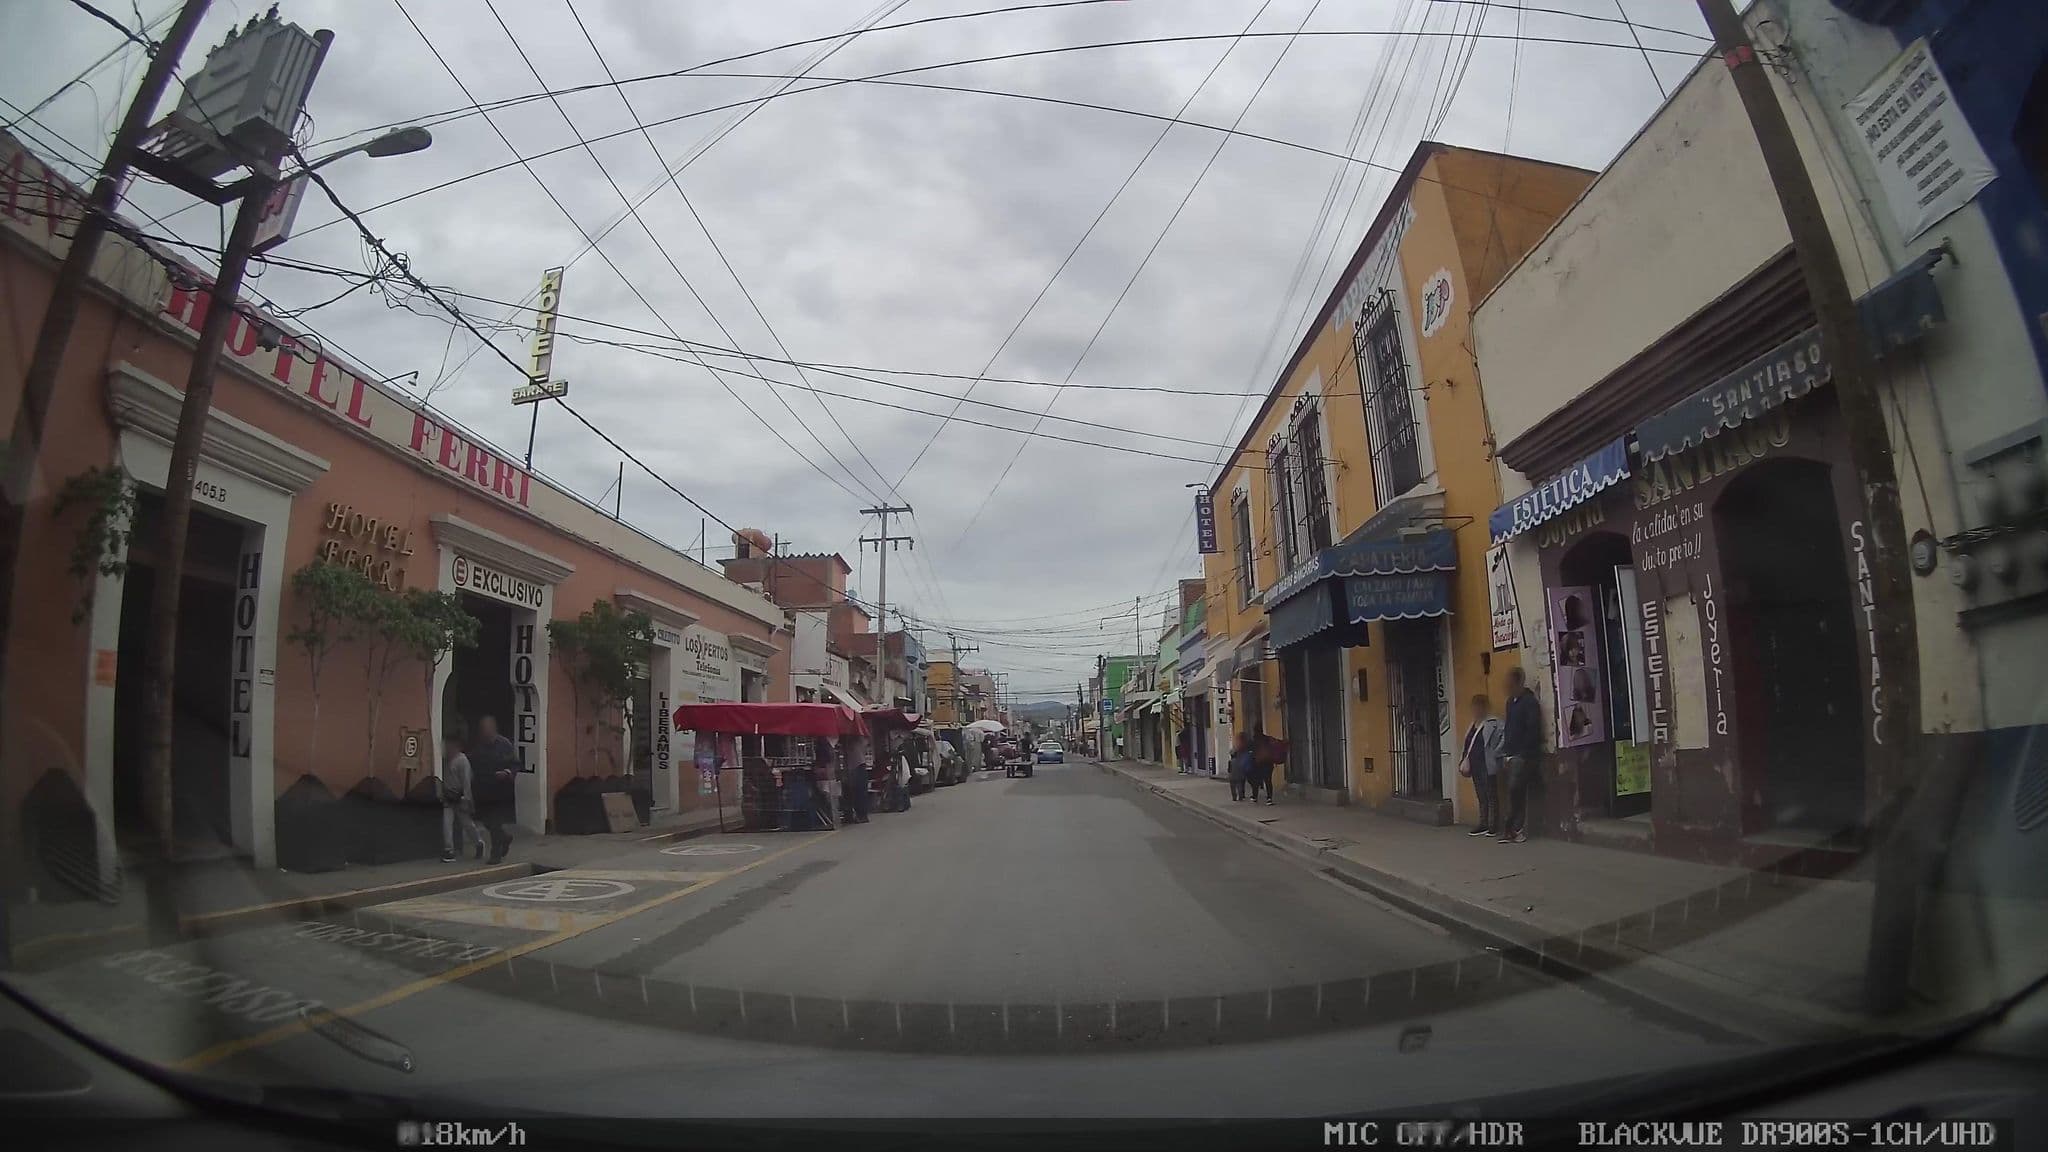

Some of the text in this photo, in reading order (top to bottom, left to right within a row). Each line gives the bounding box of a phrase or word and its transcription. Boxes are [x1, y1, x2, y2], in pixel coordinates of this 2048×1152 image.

[530, 271, 561, 378] HOTEL
[168, 266, 529, 508] HOTEL FERRI
[511, 381, 564, 400] GARAGE
[326, 503, 415, 557] HOTEL
[1200, 496, 1213, 549] HOTEL
[1680, 507, 1691, 527] en
[1693, 501, 1704, 521] su
[324, 539, 408, 592] FERRI
[1642, 532, 1702, 572] Juto preio!!
[473, 566, 543, 608] EXCLUSIVO
[232, 553, 261, 758] HOTEL
[1642, 601, 1668, 744] ESTETICA
[1704, 573, 1728, 735] Joyeria
[514, 624, 536, 774] HOTEL
[1217, 681, 1228, 725] OTEL
[656, 691, 670, 770] LIBERAMOS
